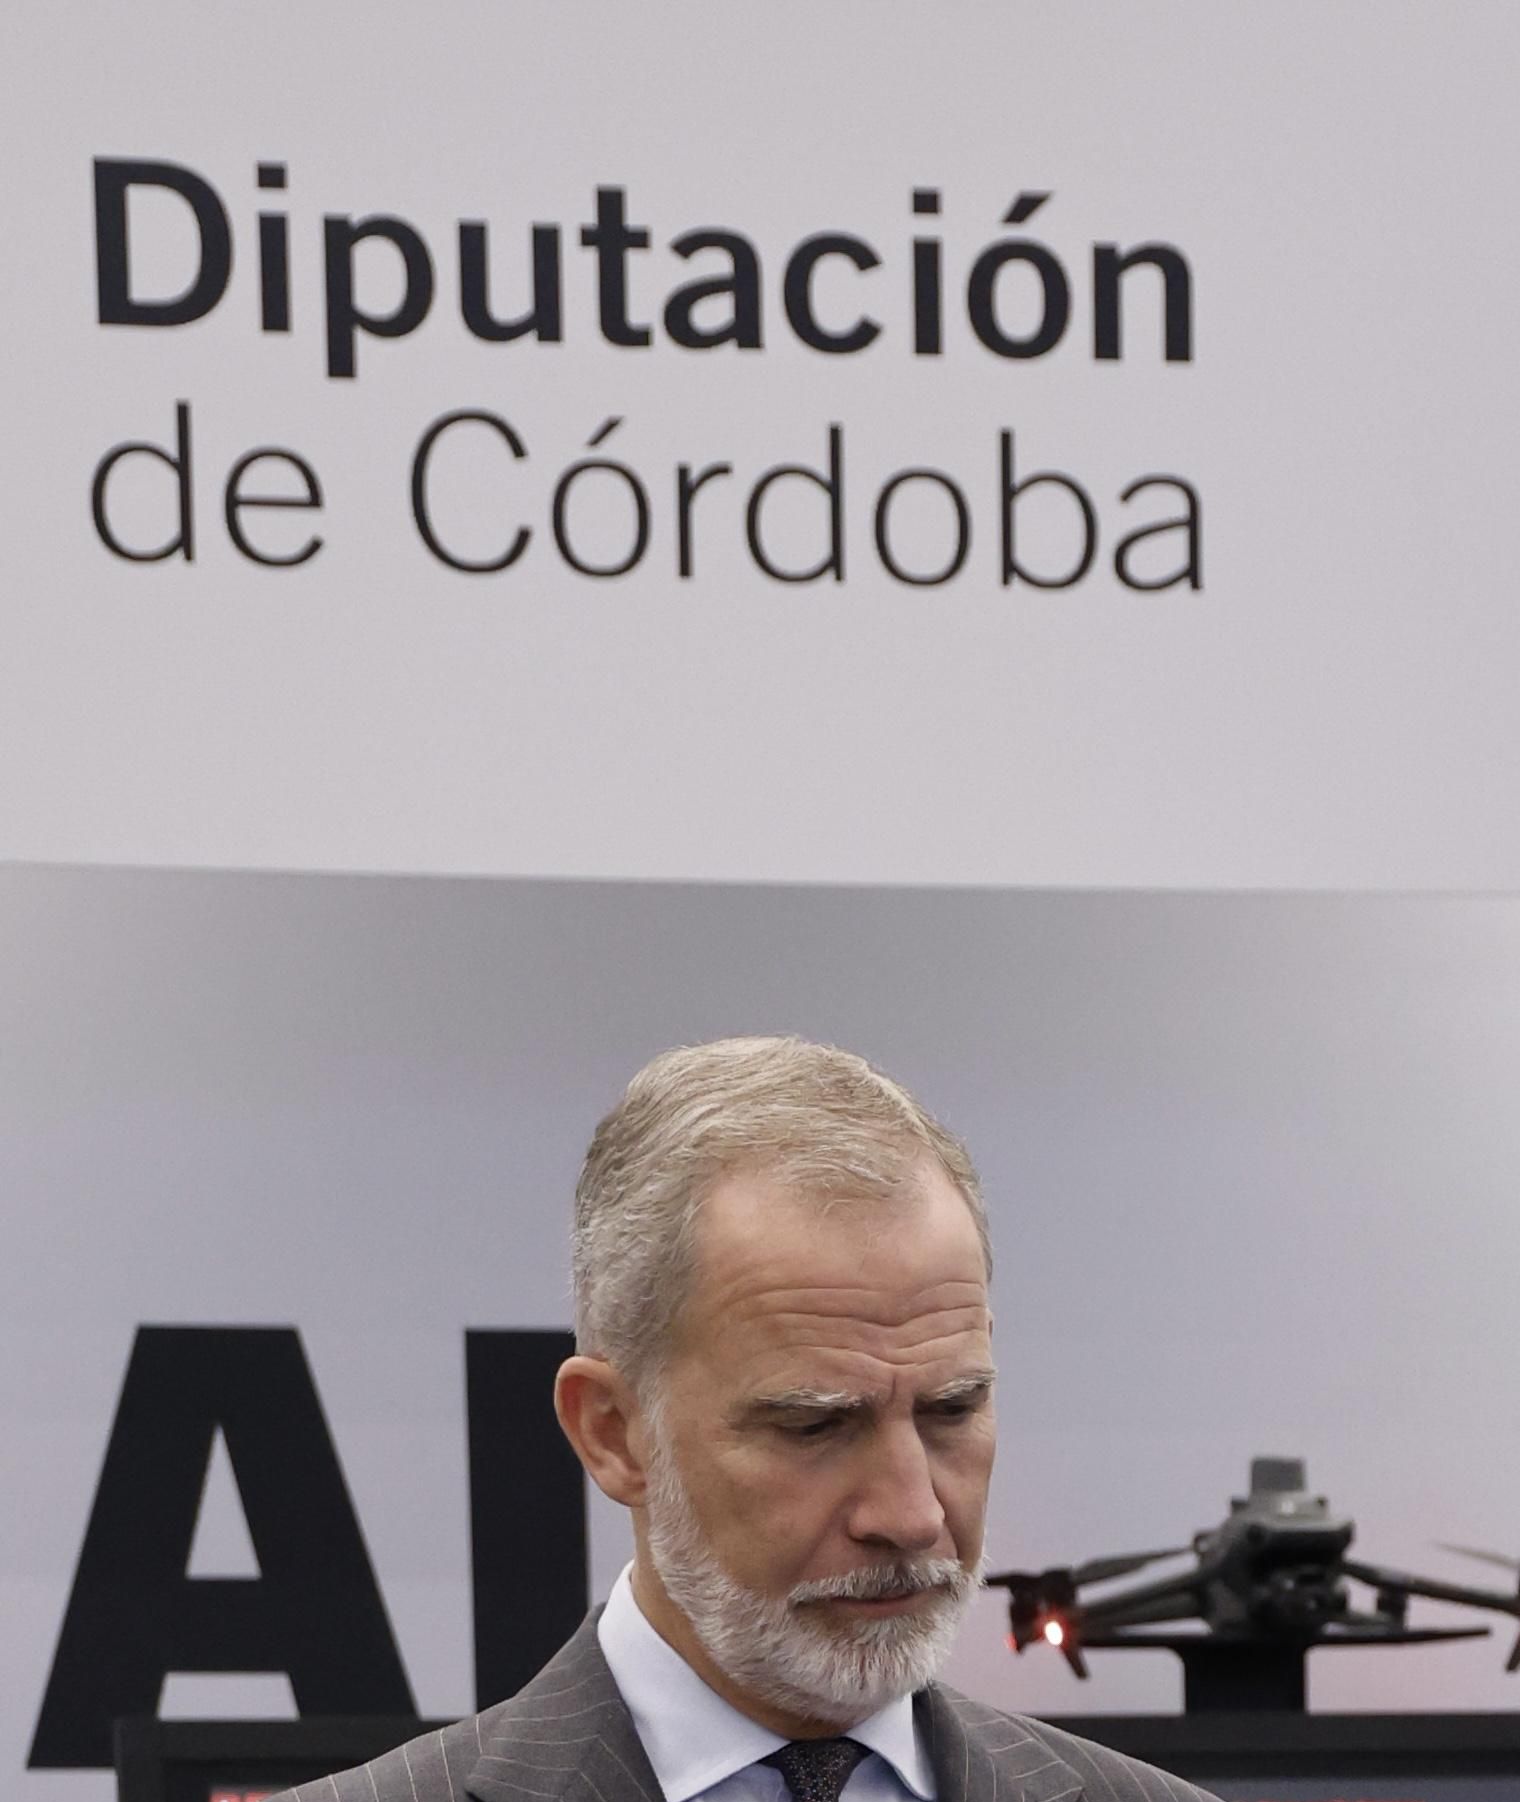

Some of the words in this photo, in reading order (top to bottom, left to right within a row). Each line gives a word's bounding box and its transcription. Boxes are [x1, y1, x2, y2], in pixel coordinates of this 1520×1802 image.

[91, 153, 1197, 381] Diputación
[89, 401, 325, 568] de
[410, 411, 1206, 592] Córdoba
